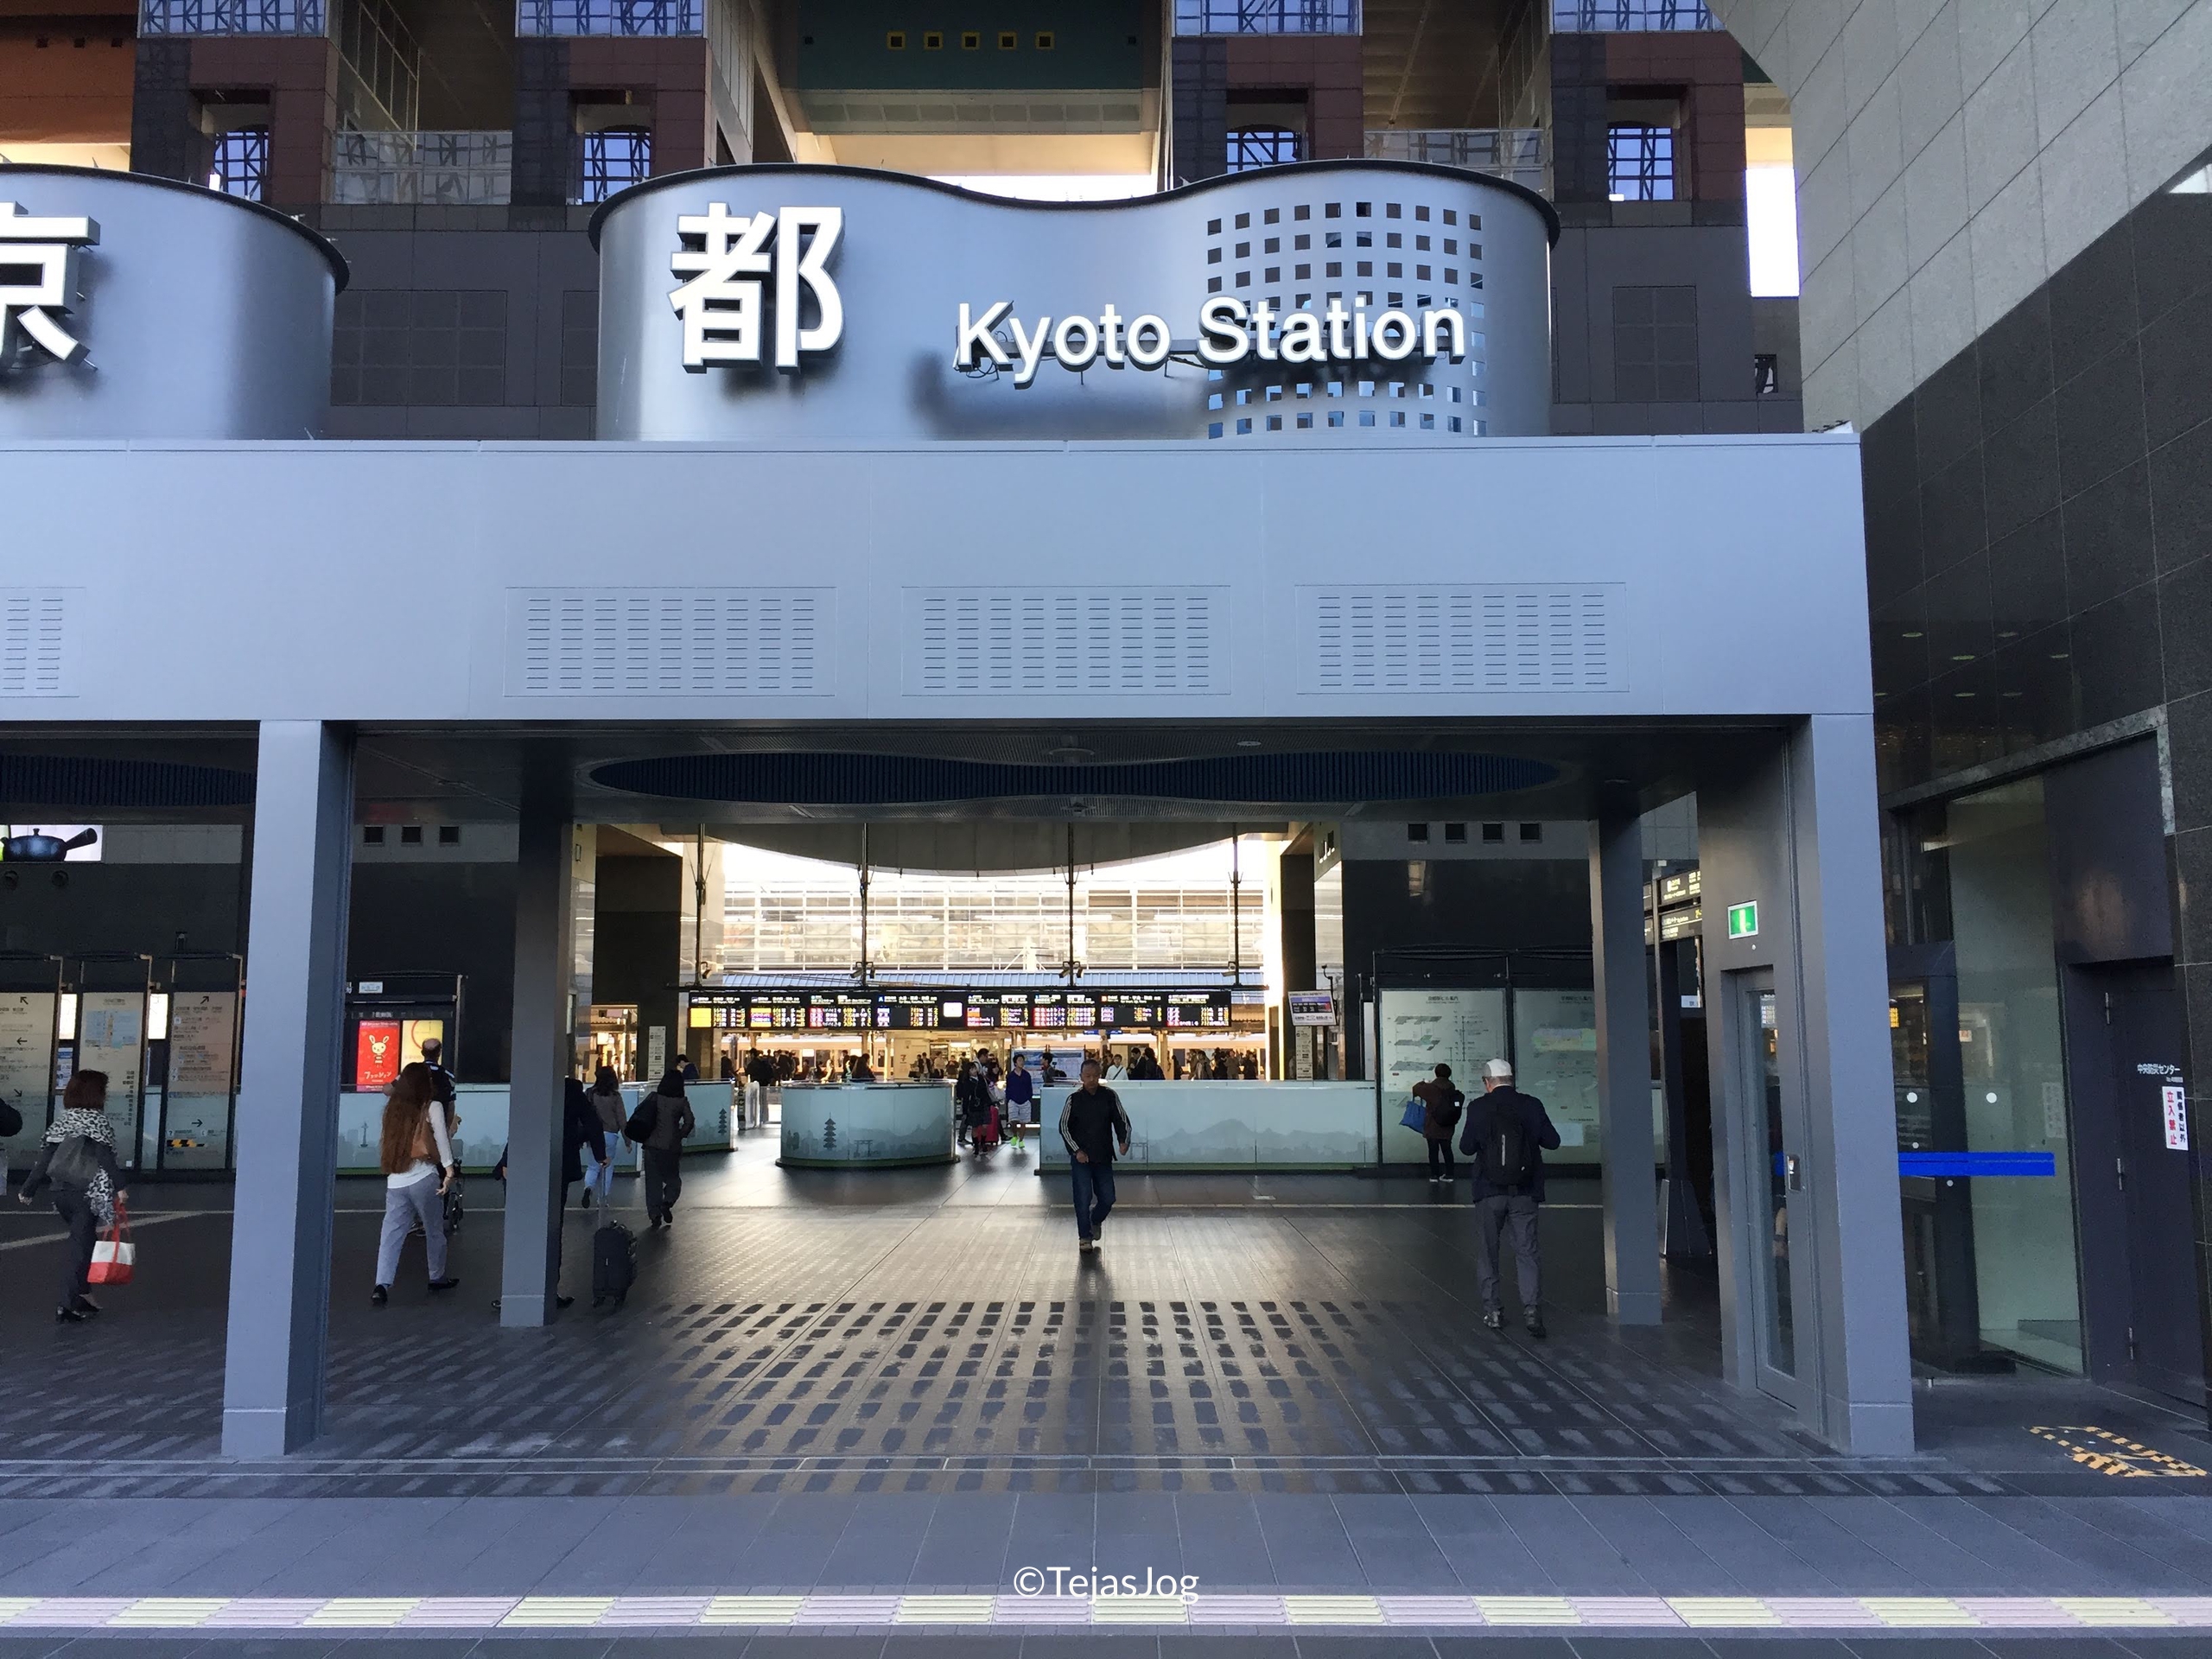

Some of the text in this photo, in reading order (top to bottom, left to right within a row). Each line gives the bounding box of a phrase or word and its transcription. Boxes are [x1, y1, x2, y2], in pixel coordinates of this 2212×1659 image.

[667, 202, 843, 370] 都
[956, 296, 1466, 388] Kyoto Station
[2137, 1063, 2181, 1075] 中央防災センター
[2166, 1090, 2177, 1146] 立入禁止
[2177, 1090, 2187, 1143] 関係者以外
